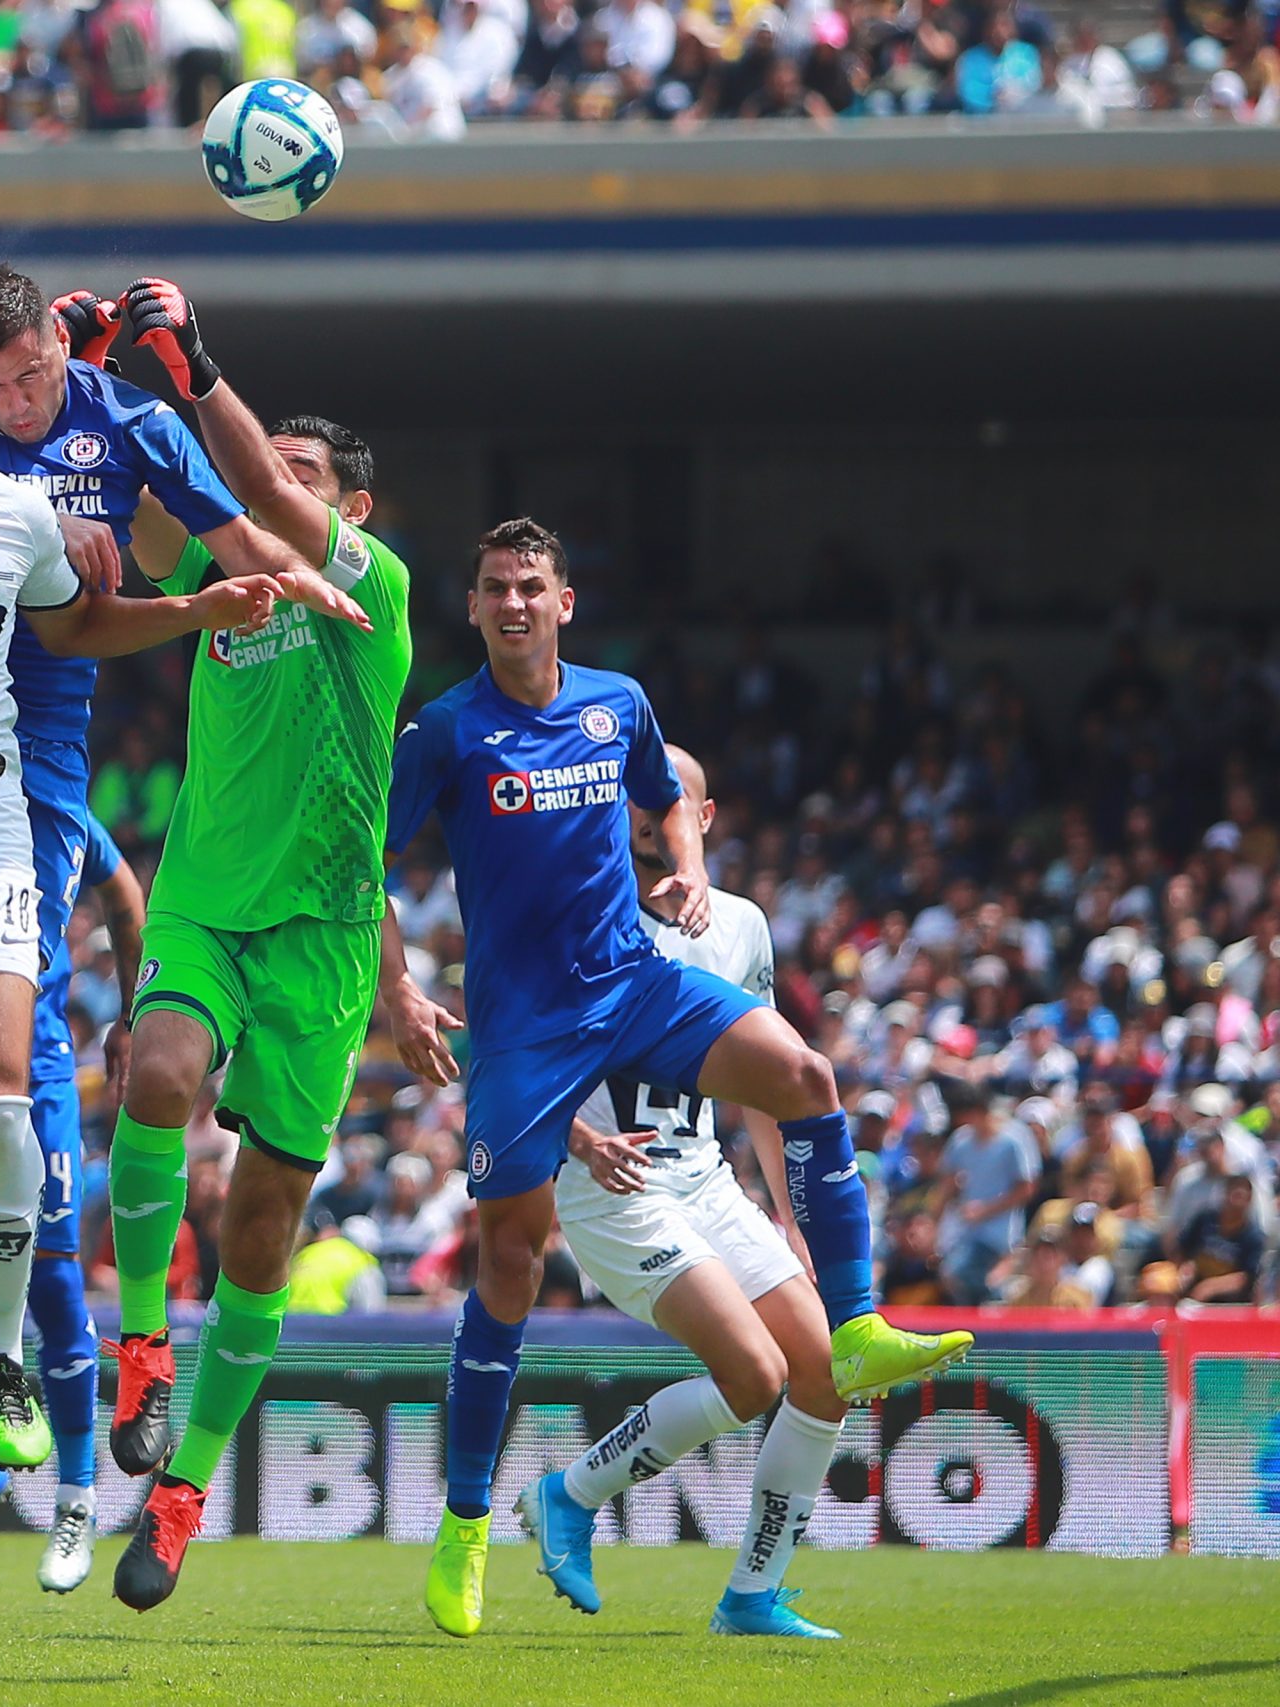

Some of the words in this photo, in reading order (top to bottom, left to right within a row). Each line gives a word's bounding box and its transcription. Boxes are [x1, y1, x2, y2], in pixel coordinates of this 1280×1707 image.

[255, 122, 284, 147] BBVA
[55, 495, 109, 516] AZUL
[230, 639, 279, 669] CRUZ
[529, 760, 620, 789] CEMENTO
[533, 788, 581, 812] CRUZ
[4, 882, 29, 933] 18
[50, 1152, 73, 1203] 4
